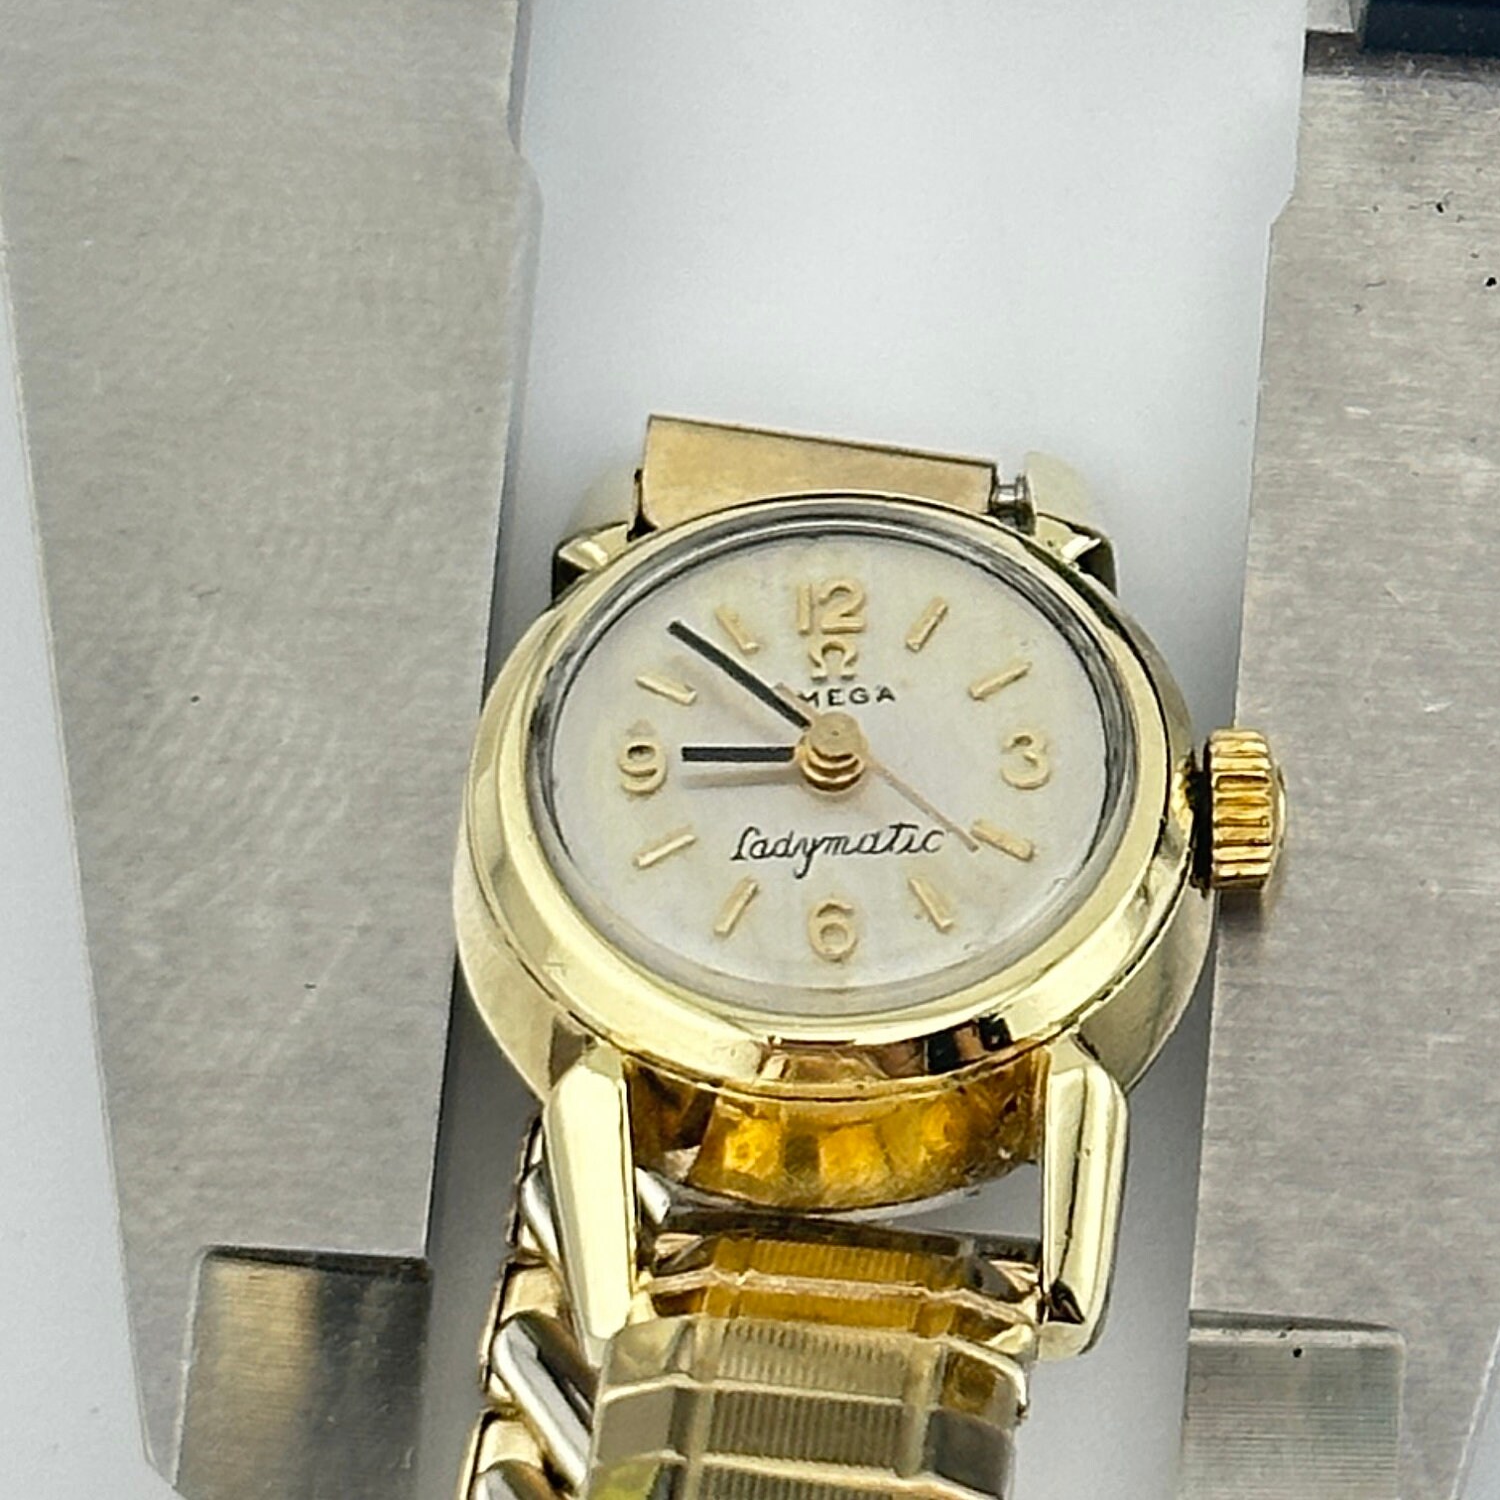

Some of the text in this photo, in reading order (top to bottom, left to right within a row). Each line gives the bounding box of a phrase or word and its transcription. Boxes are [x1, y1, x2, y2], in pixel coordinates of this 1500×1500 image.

[796, 579, 866, 636] 12
[796, 684, 897, 709] MEGA
[618, 739, 667, 795] 9
[1001, 730, 1051, 790] 3
[730, 822, 946, 880] Ladymatic
[808, 901, 859, 962] 6
